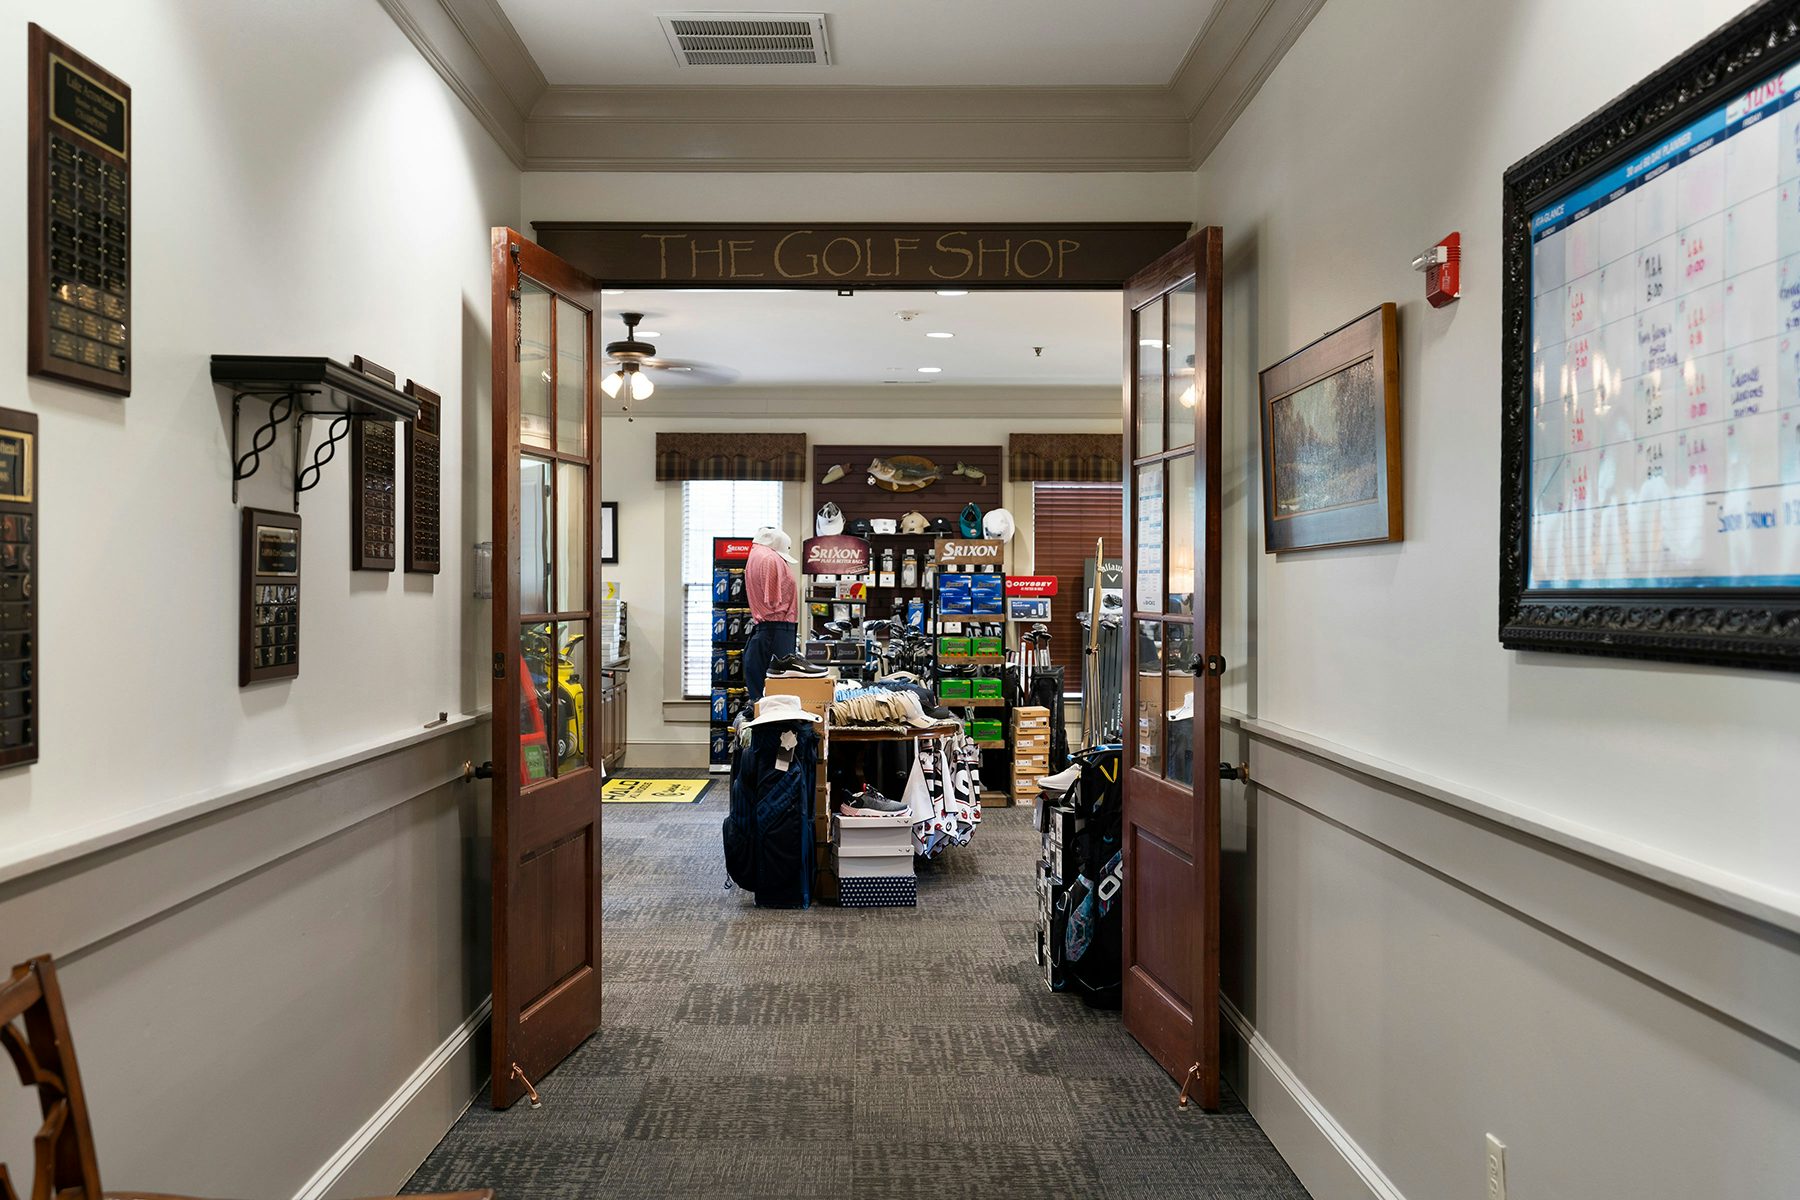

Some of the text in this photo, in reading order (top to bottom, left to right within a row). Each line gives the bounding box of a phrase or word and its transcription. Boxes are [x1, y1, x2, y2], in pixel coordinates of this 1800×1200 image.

[1743, 73, 1786, 115] JUNE
[642, 230, 1081, 279] THE GOLF SHOP
[1442, 263, 1450, 289] FIRE
[808, 545, 862, 561] SRIXON
[942, 542, 998, 560] SRIXON
